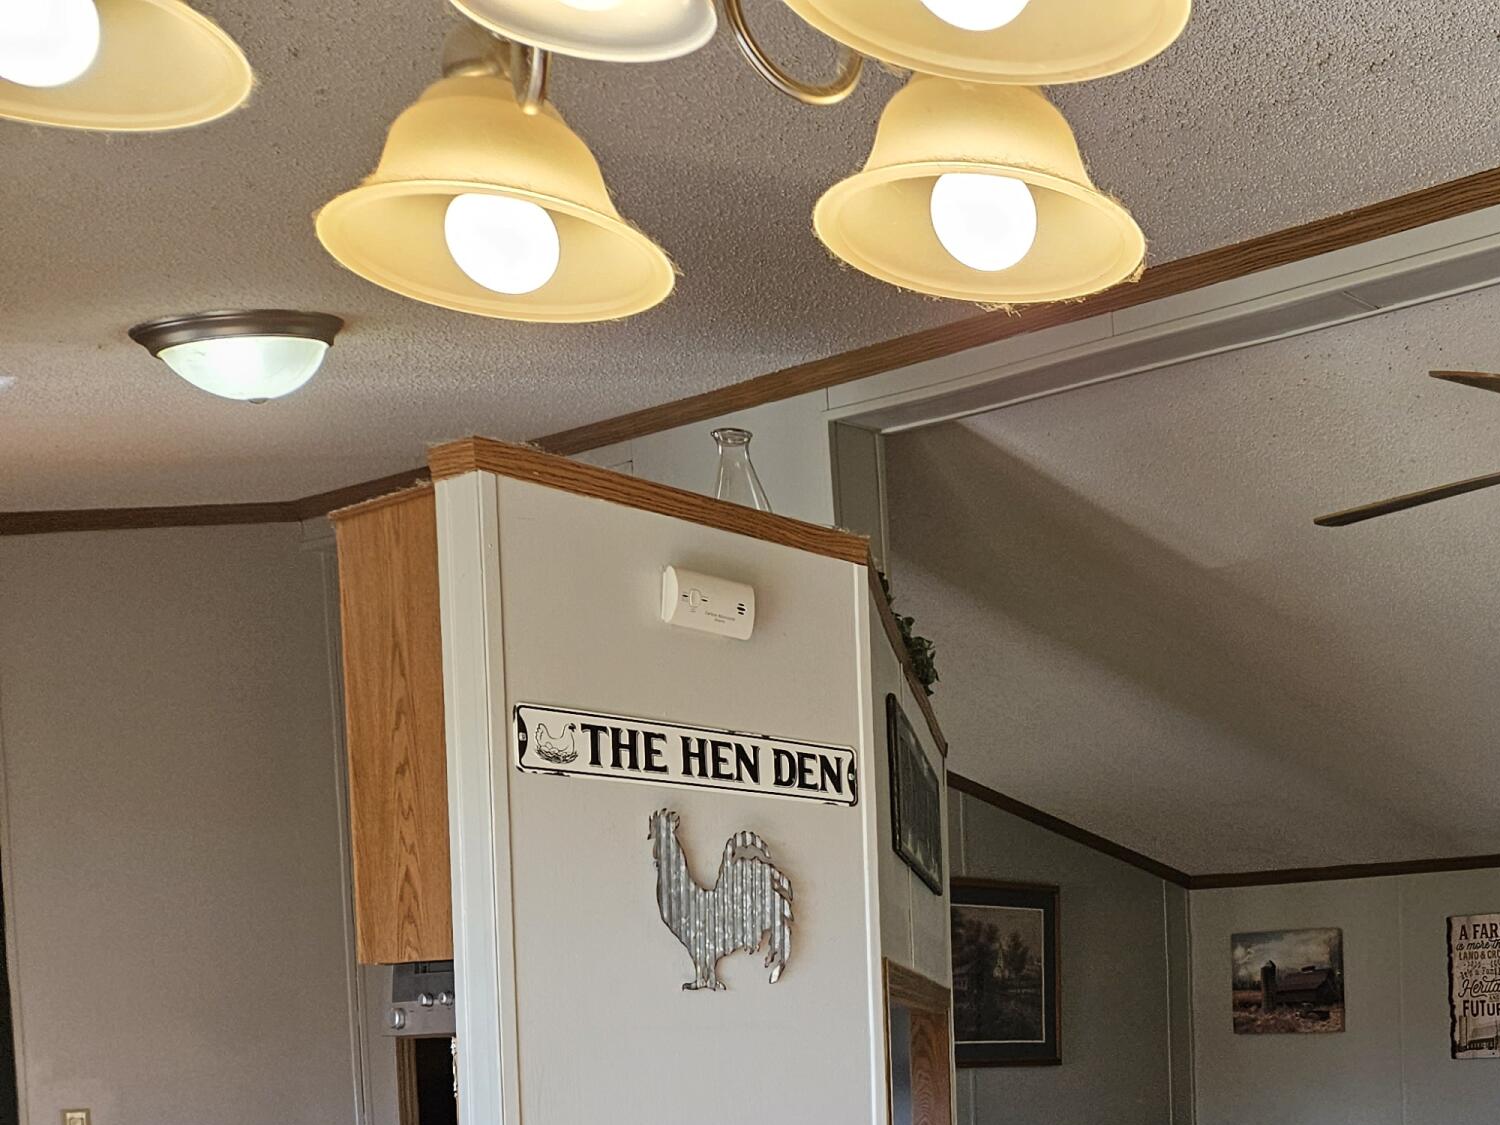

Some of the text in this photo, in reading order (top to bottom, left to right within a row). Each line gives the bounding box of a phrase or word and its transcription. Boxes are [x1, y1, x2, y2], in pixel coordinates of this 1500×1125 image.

[581, 723, 844, 794] THE HEN DEN
[1459, 924, 1468, 940] A
[1467, 941, 1491, 950] more
[1458, 950, 1479, 961] LAND
[1480, 950, 1486, 959] &
